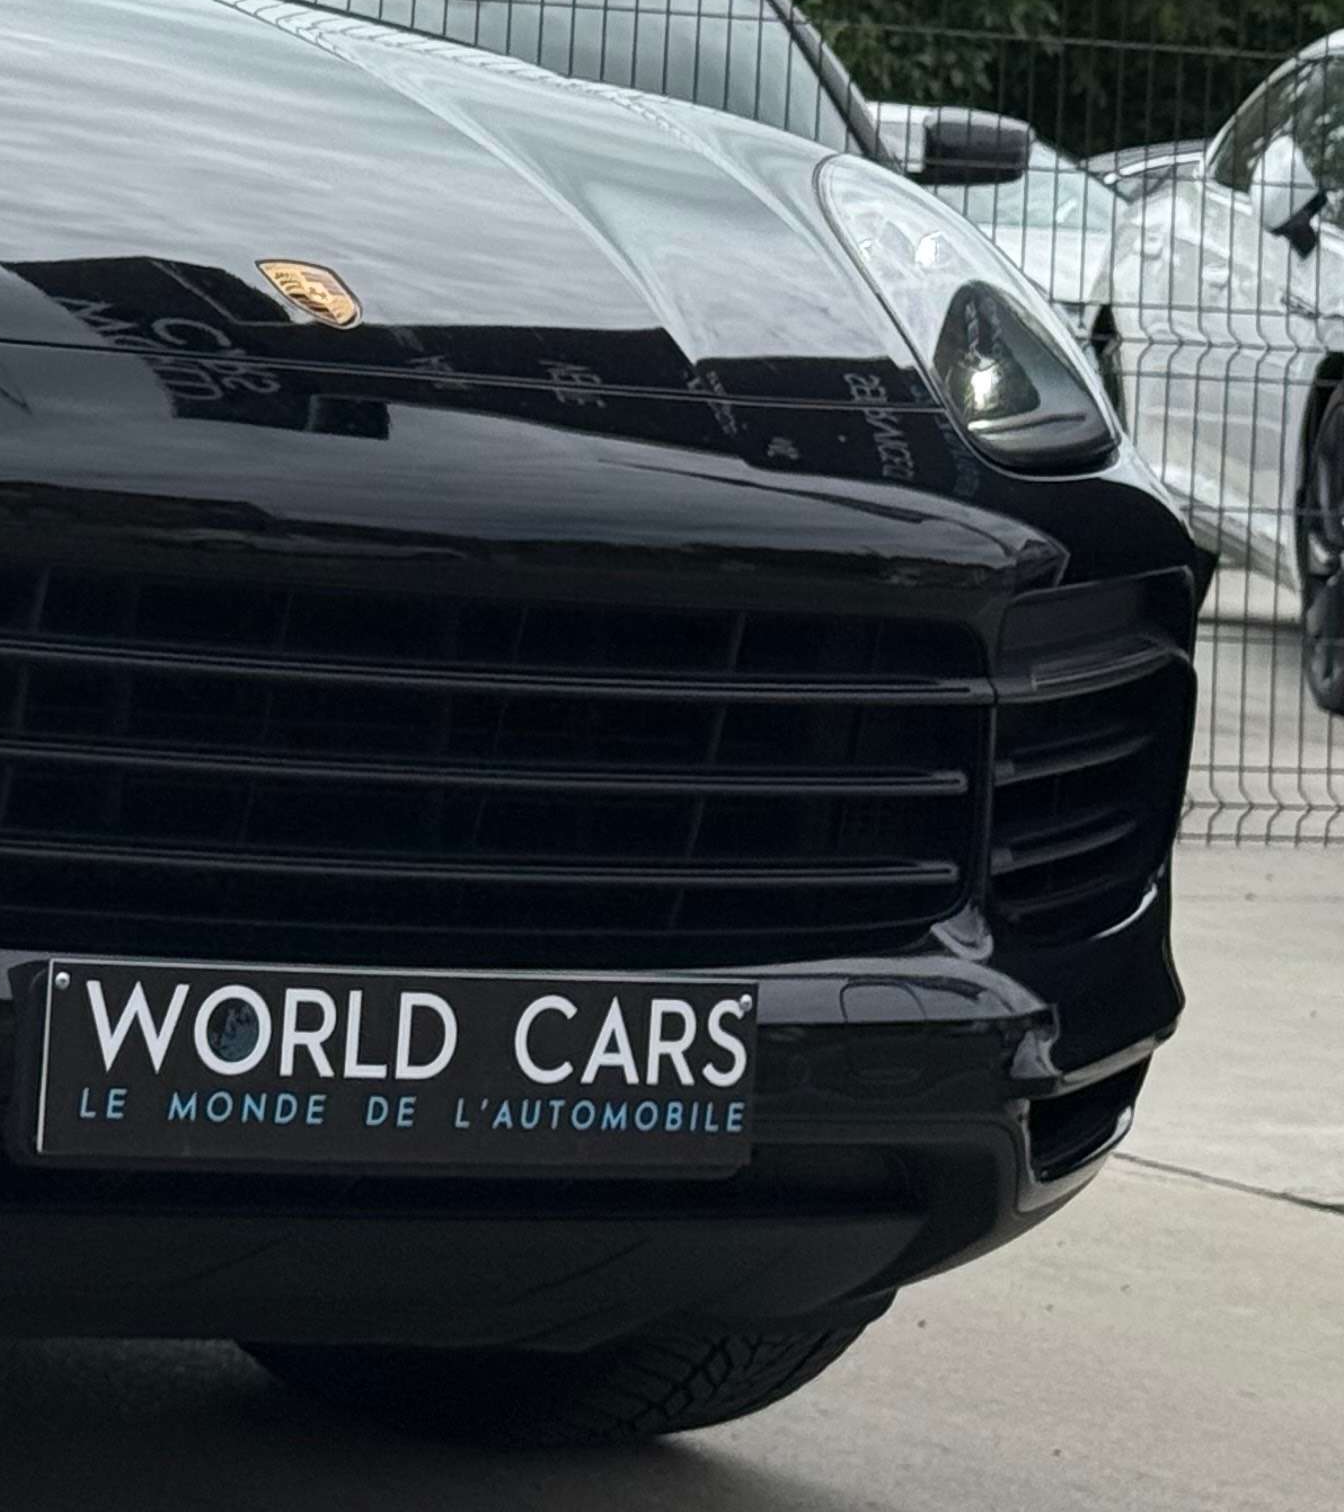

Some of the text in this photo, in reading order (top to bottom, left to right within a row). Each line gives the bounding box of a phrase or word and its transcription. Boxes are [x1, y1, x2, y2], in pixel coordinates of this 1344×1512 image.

[85, 979, 748, 1087] WORLD CARS
[78, 1087, 745, 1133] LE MONDE DE L'AUTOMOBILE
